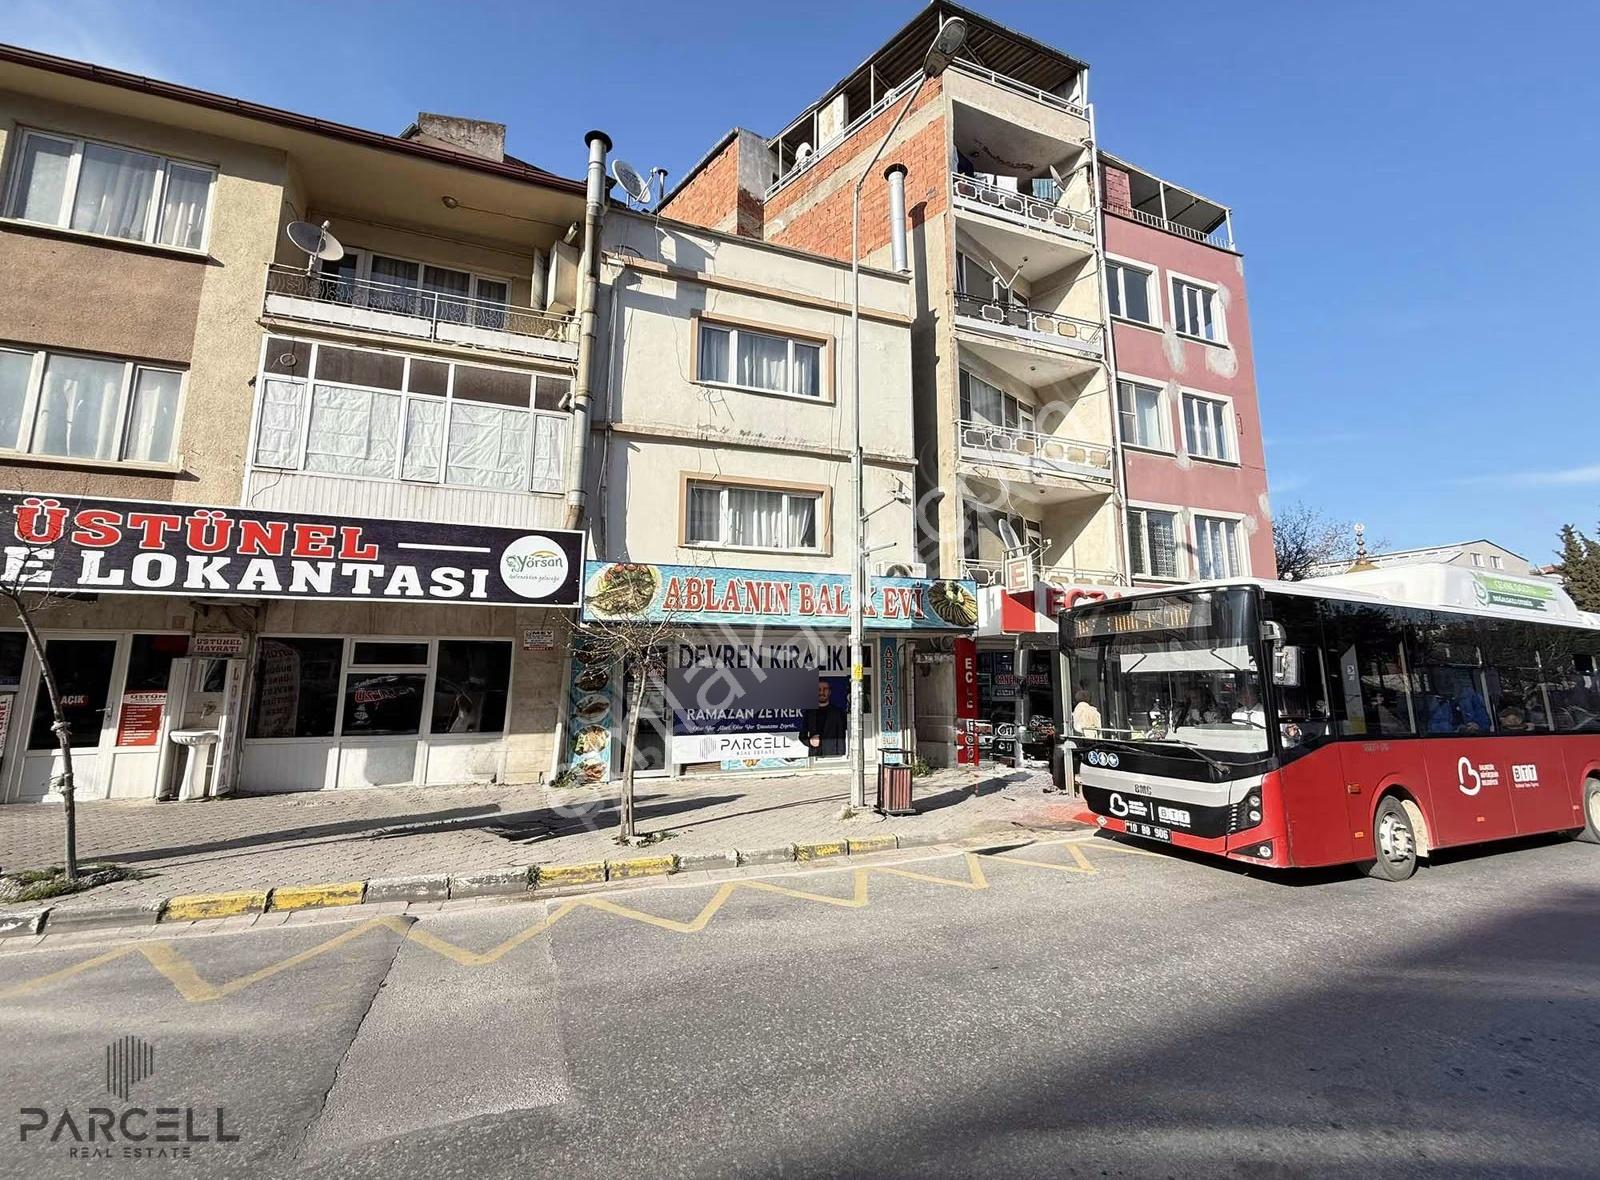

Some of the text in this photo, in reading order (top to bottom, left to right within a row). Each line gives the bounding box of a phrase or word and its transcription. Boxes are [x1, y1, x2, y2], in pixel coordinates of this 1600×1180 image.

[13, 497, 379, 561] ÜSTÜNEL
[516, 555, 563, 572] Yörsan
[77, 550, 489, 599] LOKANTASI
[1011, 563, 1025, 583] E
[798, 581, 877, 618] BALK
[882, 581, 925, 619] EVİ
[678, 644, 763, 669] DEVREN
[687, 708, 754, 720] RAMAZAN
[720, 737, 791, 751] PARCELL
[1514, 766, 1535, 780] BTT
[1160, 808, 1188, 823] BTT
